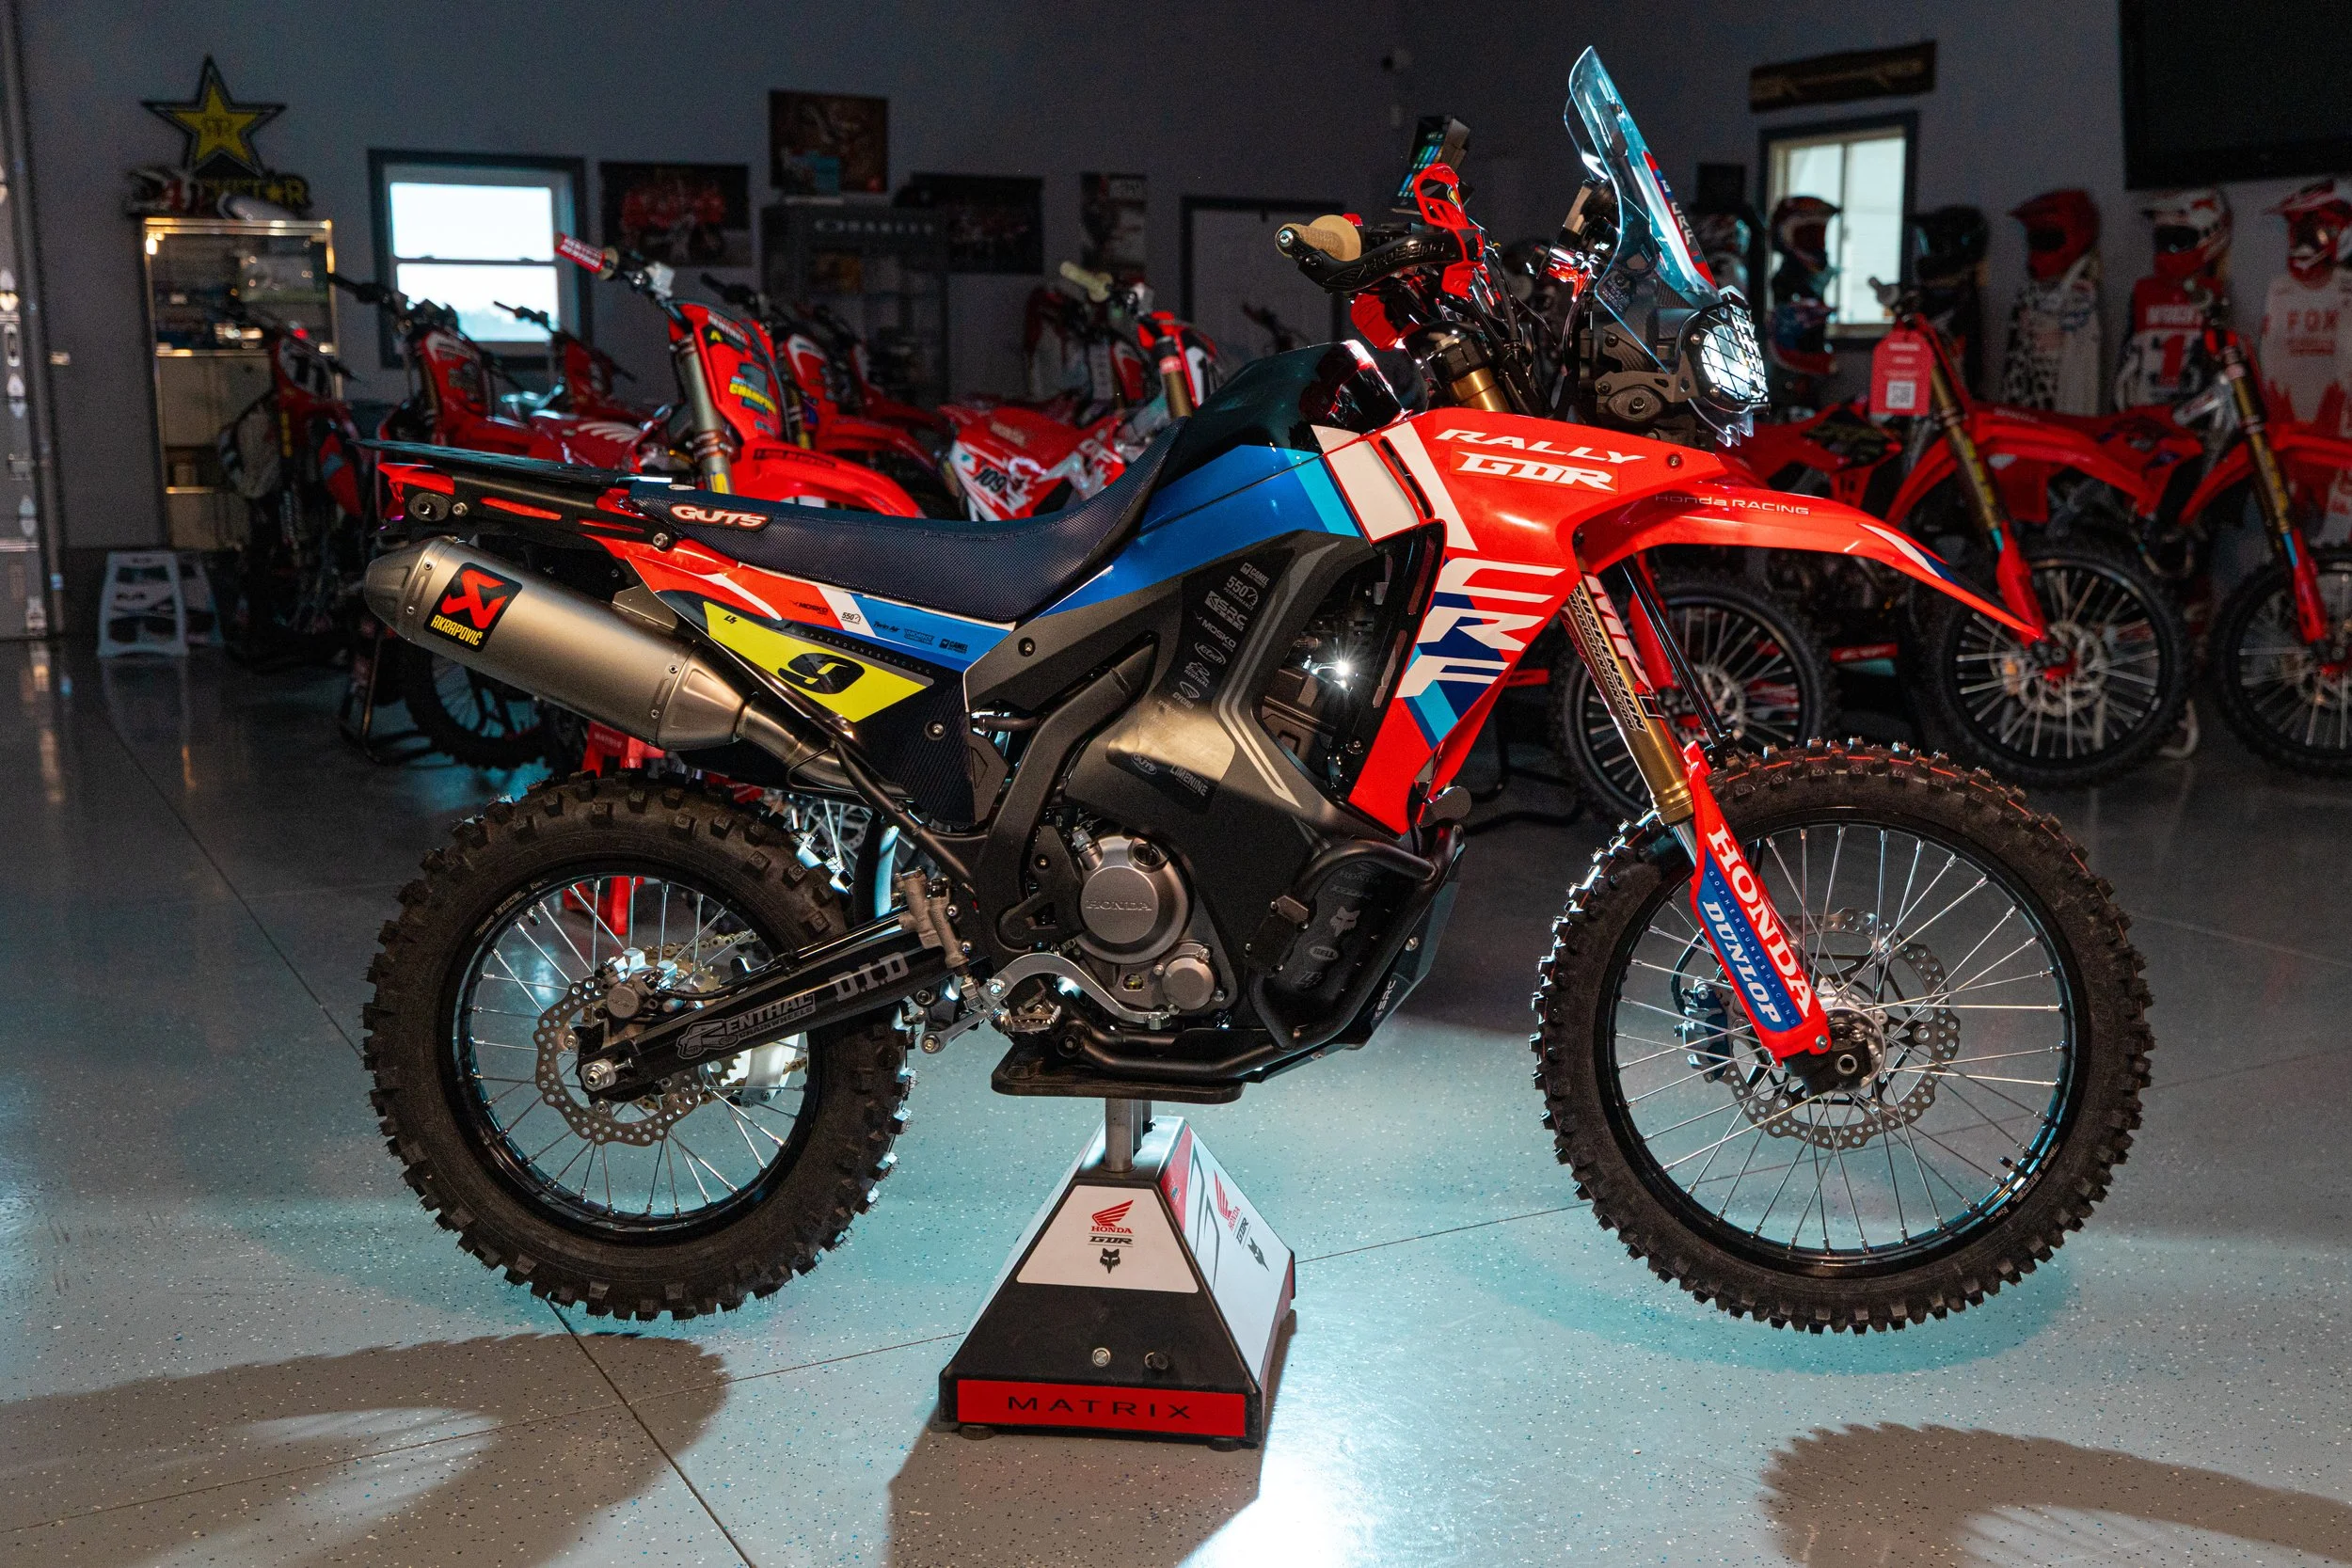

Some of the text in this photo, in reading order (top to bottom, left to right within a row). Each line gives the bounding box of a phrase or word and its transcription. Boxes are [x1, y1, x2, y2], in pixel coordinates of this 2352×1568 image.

[1434, 428, 1648, 465] RALLY
[1455, 451, 1617, 492] GDR
[670, 504, 769, 529] GUTS
[1655, 494, 1810, 515] Honda RACING
[1226, 575, 1249, 598] 550
[1249, 567, 1270, 586] CAMEL
[841, 611, 855, 621] 550
[1217, 598, 1249, 626] SRC
[1201, 619, 1237, 650] MOSKO
[1394, 557, 1566, 700] CRF
[948, 641, 969, 651] CAMEL
[1574, 584, 1648, 734] SUSPENSION
[1183, 669, 1210, 689] RENTHAL
[1172, 691, 1196, 711] CYCRA
[1169, 765, 1209, 797] LIMENINE
[1085, 899, 1153, 912] HONDA
[1707, 824, 1813, 1018] HONDA
[1702, 900, 1783, 1024] DUNLOP
[1378, 979, 1397, 1011] SRC
[677, 993, 816, 1057] RENTHAL
[1090, 1226, 1134, 1234] HONDA
[1227, 1205, 1241, 1232] HONDA
[1235, 1216, 1249, 1245] GDR
[1089, 1235, 1134, 1245] GDR
[1007, 1396, 1192, 1420] MATRIX
